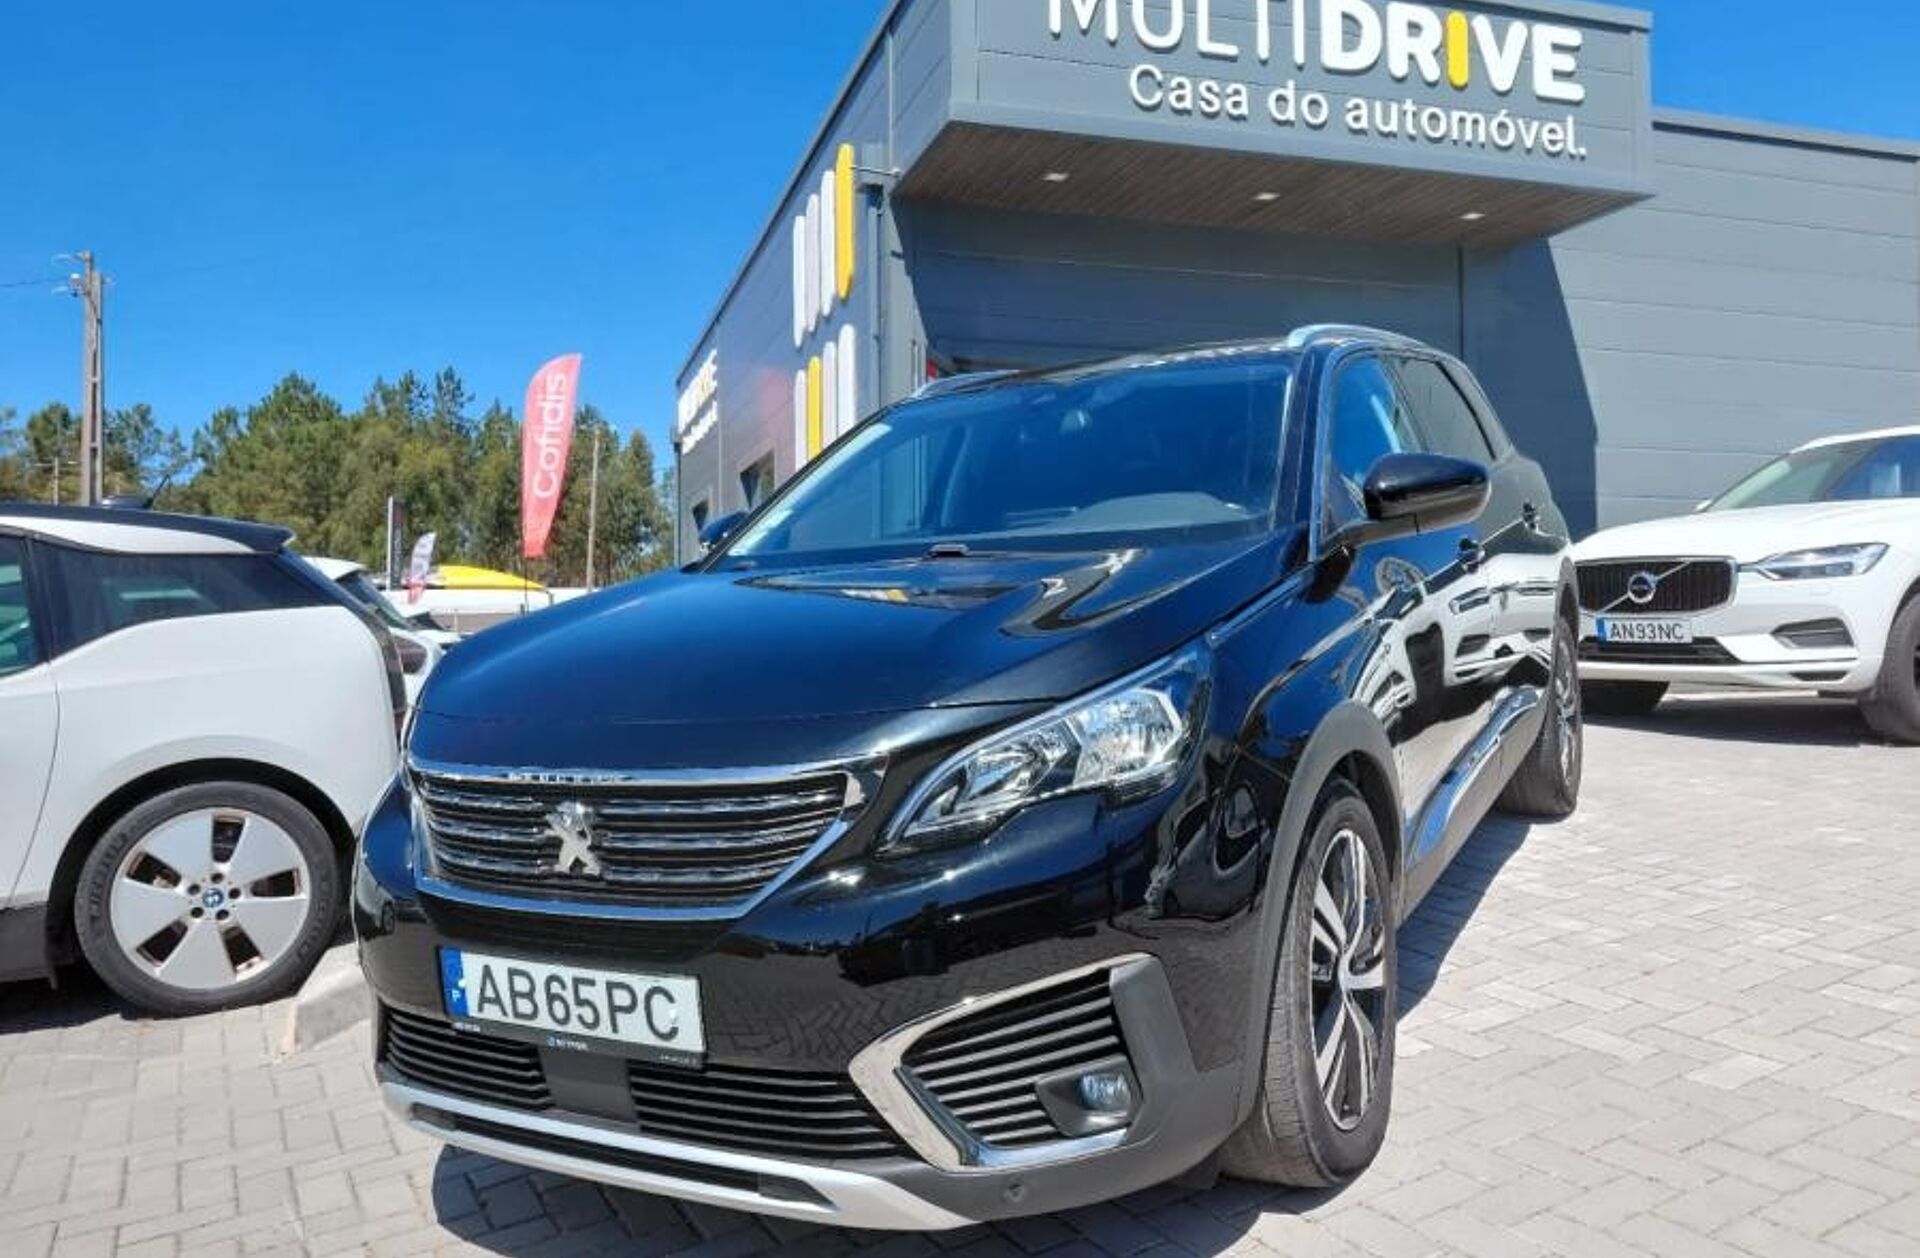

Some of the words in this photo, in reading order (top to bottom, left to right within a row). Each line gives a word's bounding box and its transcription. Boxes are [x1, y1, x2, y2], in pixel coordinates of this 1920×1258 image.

[1130, 64, 1249, 113] Casa
[1268, 80, 1329, 125] do
[1345, 97, 1587, 155] automóvel.
[532, 372, 567, 498] Cofidis
[1610, 622, 1684, 640] AN93NC
[477, 964, 680, 1042] AB65PC
